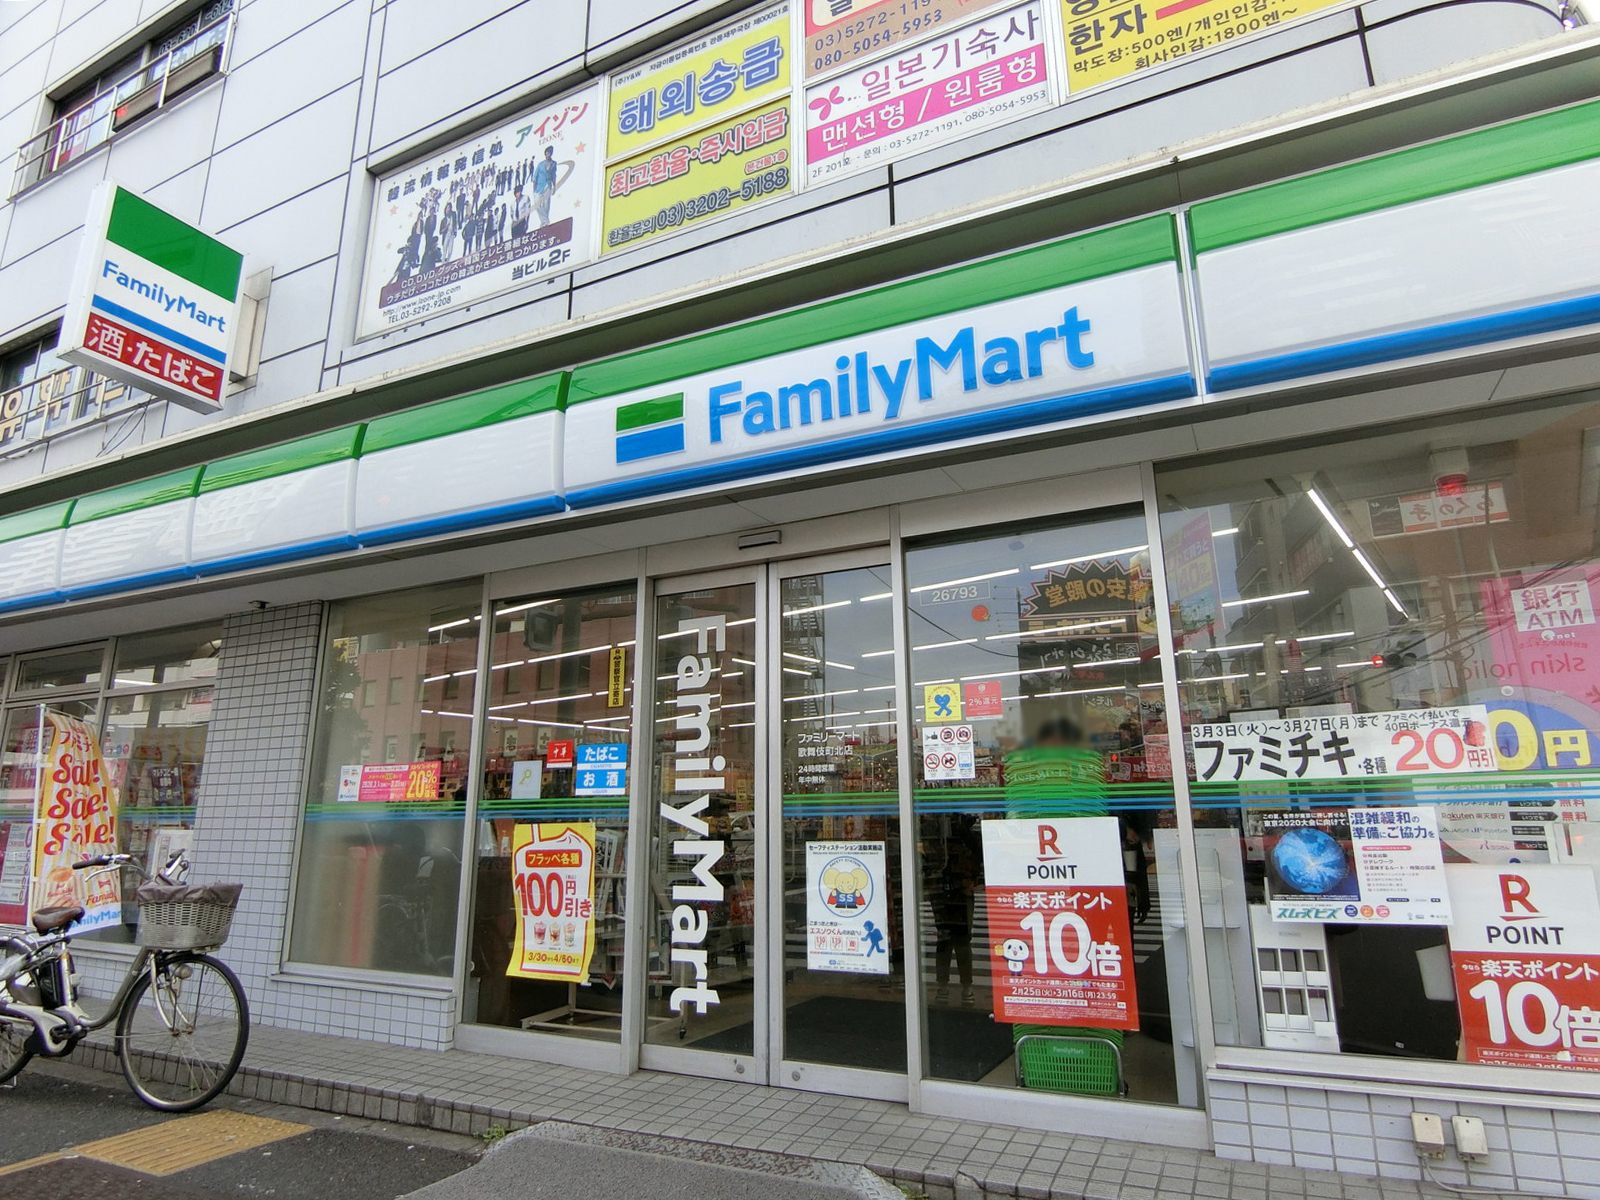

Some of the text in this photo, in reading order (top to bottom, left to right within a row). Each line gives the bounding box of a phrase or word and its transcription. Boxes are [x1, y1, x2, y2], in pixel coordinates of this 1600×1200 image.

[814, 8, 943, 70] 080-5054-5953
[815, 0, 941, 51] 03)5272-119
[1068, 4, 1148, 56] 한자
[1074, 0, 1285, 73] 막도장:500엔/개인인감:
[862, 9, 1039, 102] 일본기숙사
[618, 35, 784, 134] 해외송금
[822, 102, 906, 152] 맨션형
[944, 51, 1038, 109] 원룸형
[515, 103, 589, 148] アイゾン
[812, 166, 824, 178] 2F
[965, 90, 1047, 123] 080-5054-5953
[655, 167, 788, 230] 03)3202-5188
[511, 249, 571, 281] 当ビル2F
[103, 260, 226, 333] FamilyMart
[709, 305, 1095, 443] FamilyMart
[932, 585, 978, 602] 26793
[1521, 583, 1580, 611] 銀行
[1527, 608, 1585, 630] ATM
[1384, 709, 1460, 724] ファミペイ払いで
[797, 730, 860, 744] ファミリーマート
[797, 745, 854, 757] 歌舞伎町北店
[585, 746, 619, 761] たばこ
[798, 764, 835, 773] 24時間営業
[1194, 730, 1356, 781] ファミチキ
[660, 614, 726, 1014] FamilyMart
[1351, 811, 1420, 825] 混雑緩和の
[1037, 825, 1063, 855] R
[1352, 826, 1435, 839] 準備にご協力を
[528, 853, 580, 865] フラッペ各種
[1027, 864, 1078, 879] POINT
[515, 872, 564, 918] 100
[839, 894, 853, 902] SS
[1013, 891, 1112, 910] 楽天ポイント
[1499, 874, 1540, 913] R
[1486, 926, 1565, 946] POINT
[1481, 960, 1599, 981] 楽天ポイント
